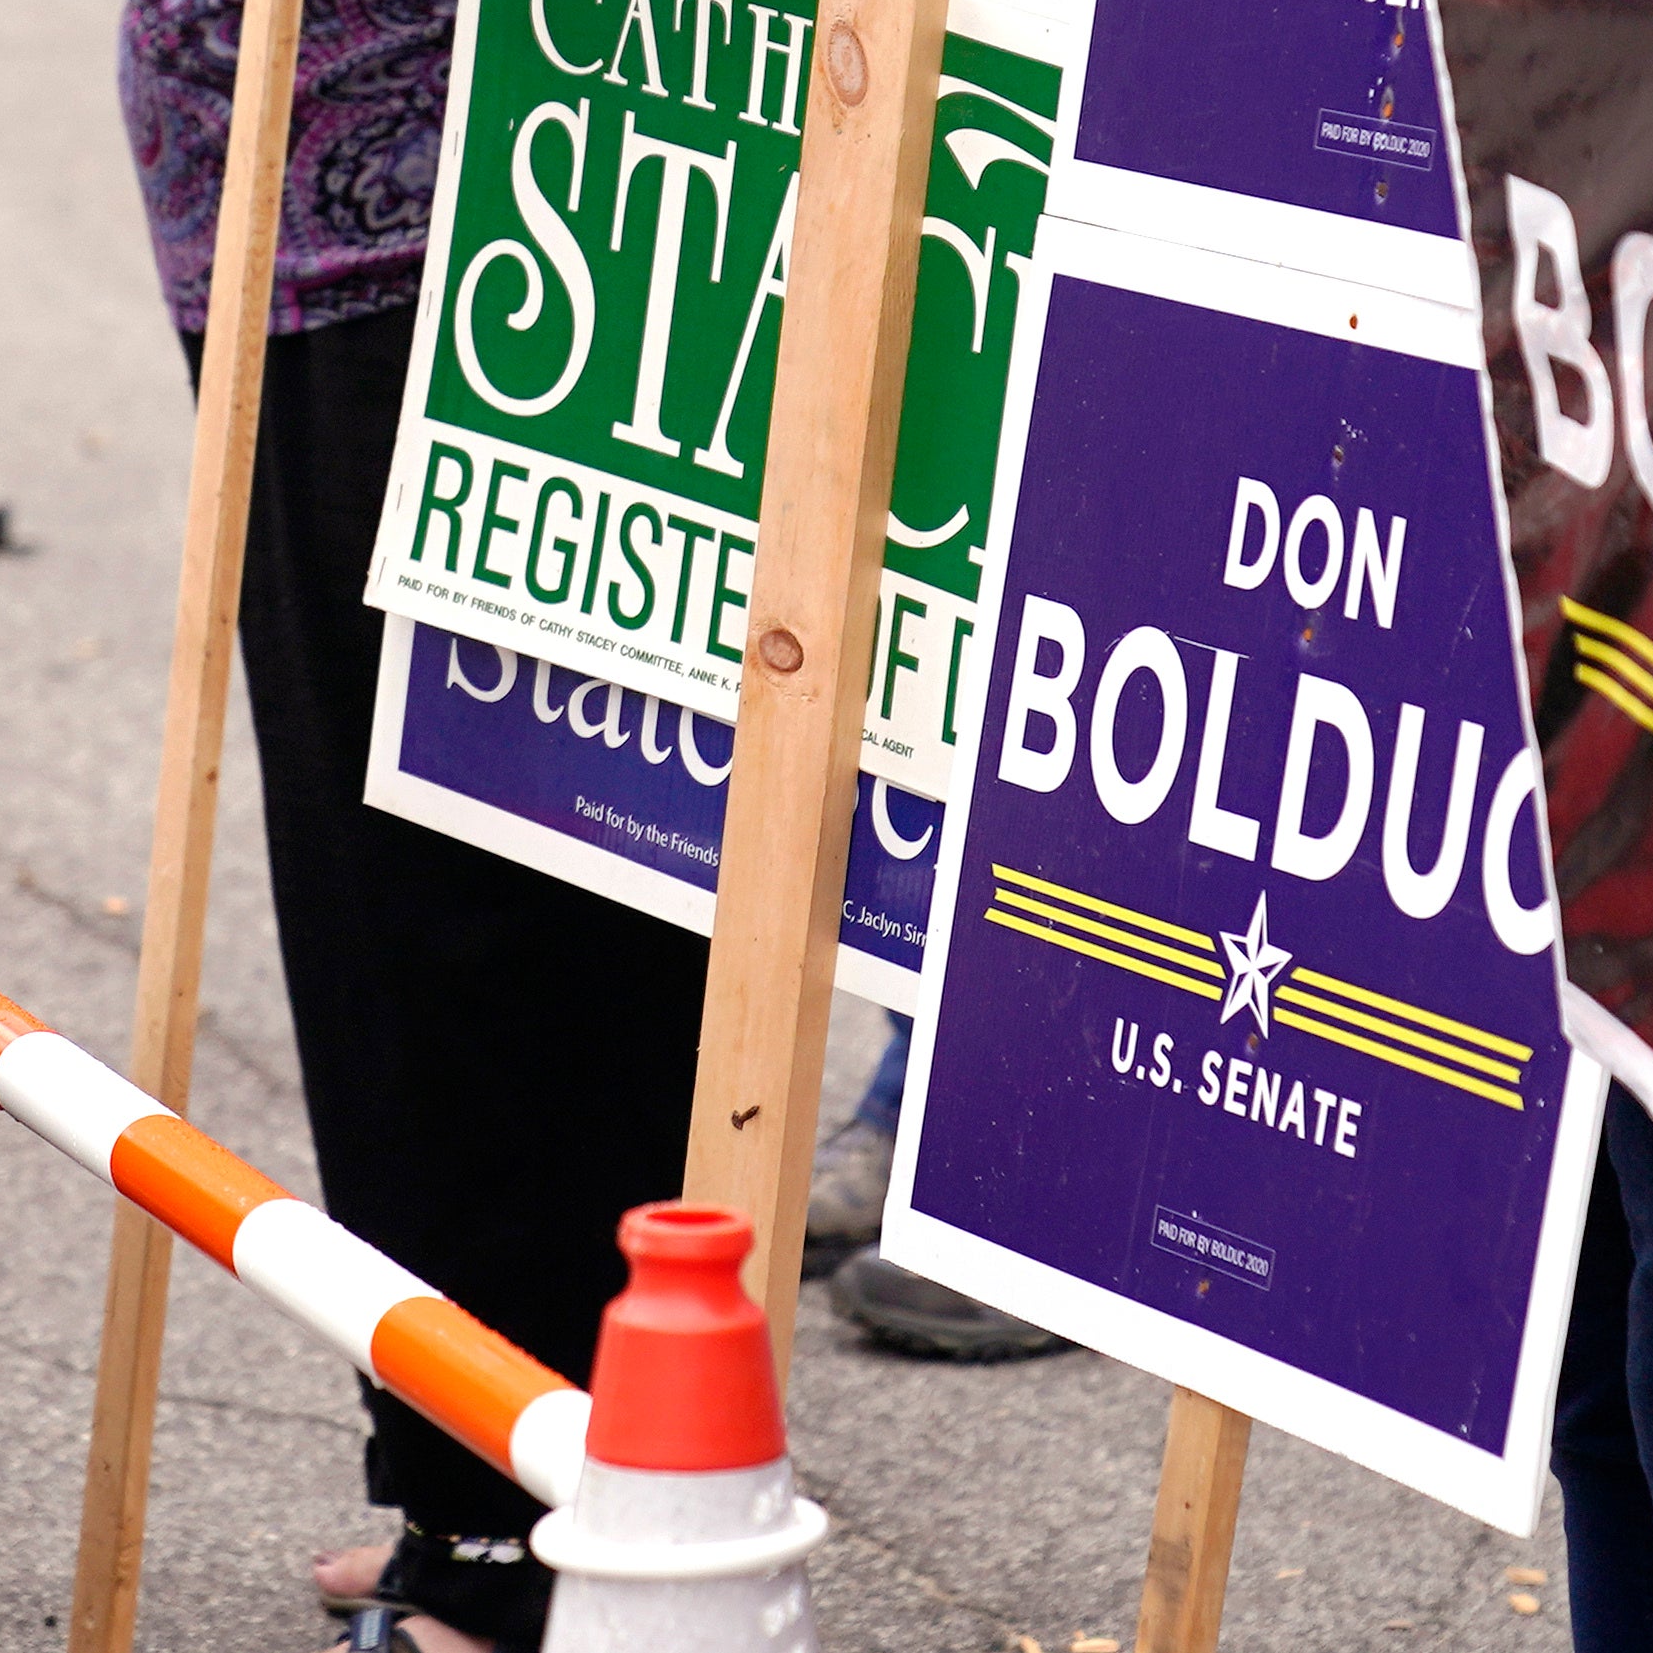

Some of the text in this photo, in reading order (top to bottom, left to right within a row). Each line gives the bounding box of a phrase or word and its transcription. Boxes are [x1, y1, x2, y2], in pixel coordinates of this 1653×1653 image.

[1321, 121, 1431, 158] PAID FOR BY BOLDUC 2020
[1223, 476, 1406, 630] DON
[397, 574, 423, 593] PAID
[426, 583, 450, 601] FOR
[452, 591, 468, 606] BY
[470, 596, 517, 622] FRIENDS
[520, 612, 536, 628] OF
[539, 618, 574, 640] CATHY
[575, 630, 618, 654] STACEY
[620, 644, 685, 678] COMMITTEE,
[688, 666, 719, 687] ANNE
[721, 676, 731, 691] K.
[882, 737, 915, 759] AGENT
[575, 795, 605, 822] Paid
[606, 806, 625, 830] for
[626, 814, 645, 842] by
[646, 823, 669, 848] the
[670, 832, 720, 867] Friends
[857, 905, 902, 939] Jaclyn
[1111, 1017, 1362, 1158] U.S. SENATE
[1158, 1219, 1269, 1277] PAID FOR BY BOLDUC 2020
